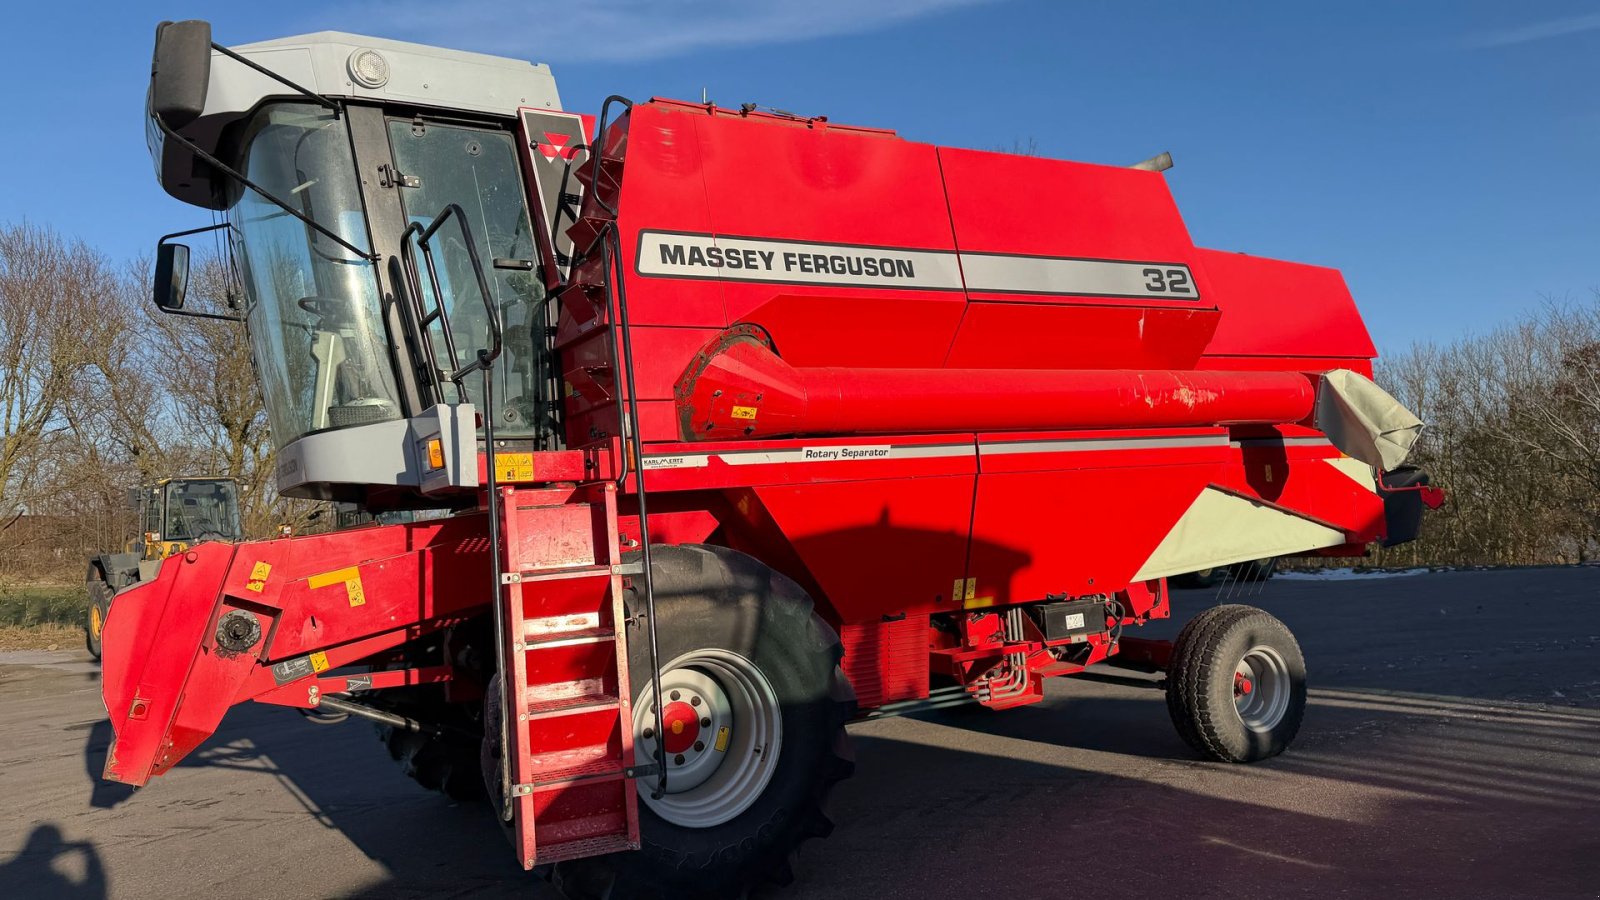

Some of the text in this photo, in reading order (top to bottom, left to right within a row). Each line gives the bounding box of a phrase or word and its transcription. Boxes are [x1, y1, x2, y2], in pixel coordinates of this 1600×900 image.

[659, 243, 915, 278] MASSEY FERGUSON
[1143, 268, 1190, 293] 32
[805, 448, 889, 460] Rotary Separator
